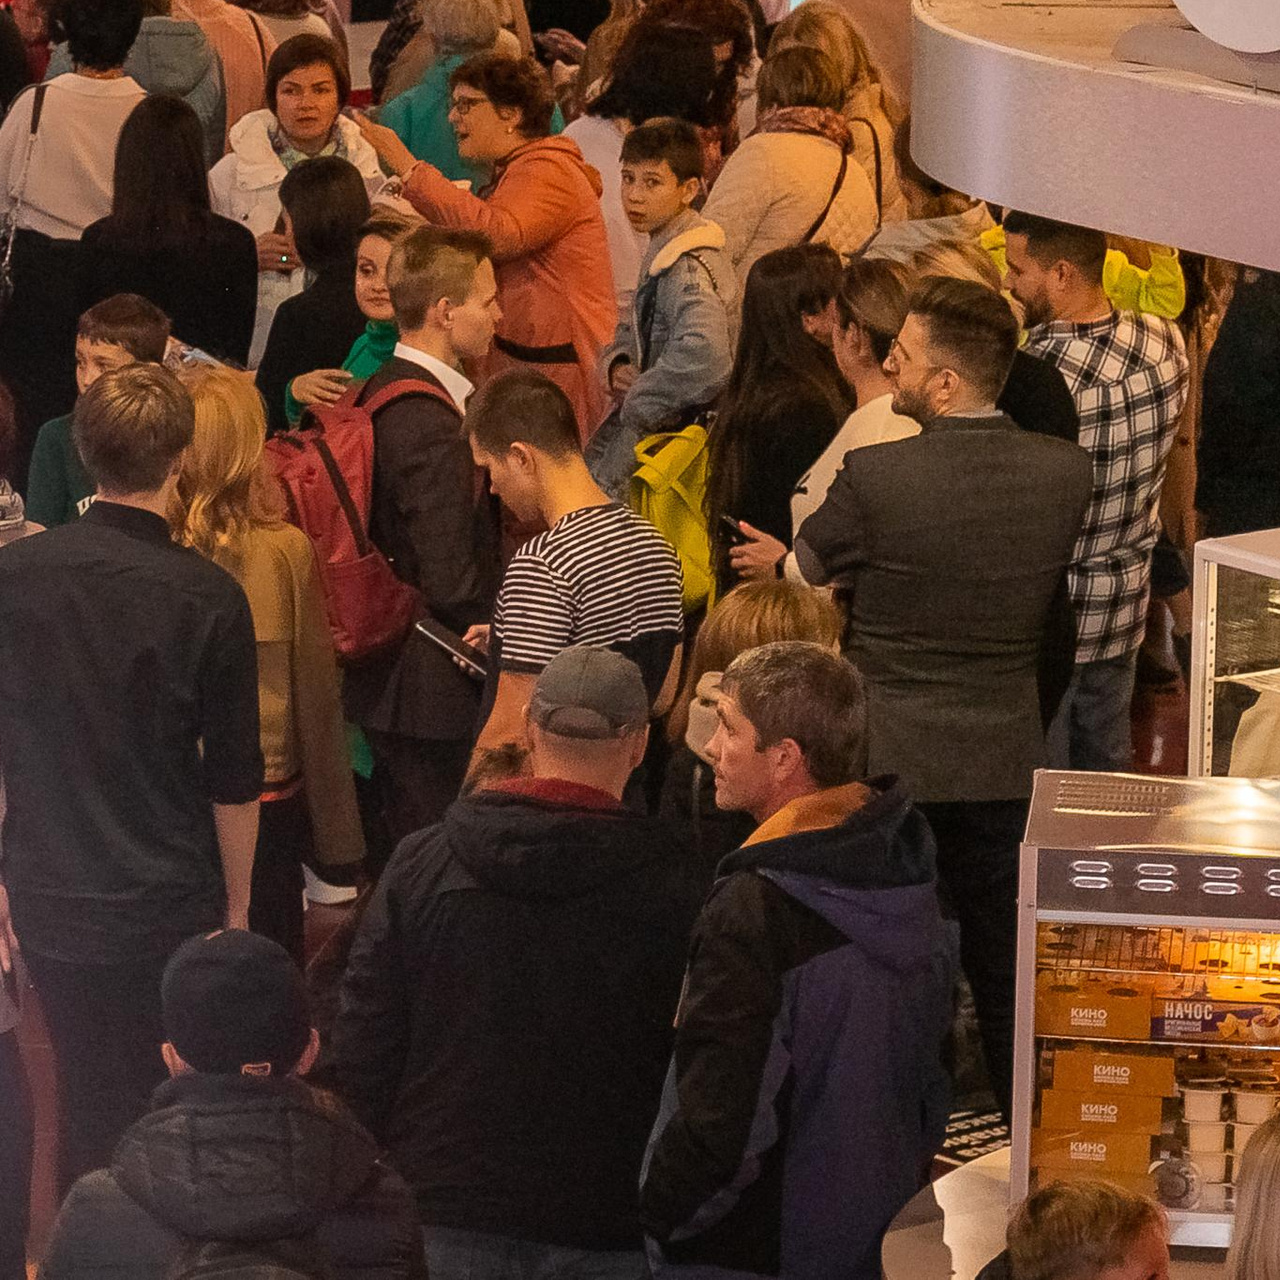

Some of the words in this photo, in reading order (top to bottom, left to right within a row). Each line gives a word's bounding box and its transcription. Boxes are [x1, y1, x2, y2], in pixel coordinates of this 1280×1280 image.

[1071, 1008, 1107, 1019] КИНО
[1165, 1001, 1213, 1020] НАЧОС
[1093, 1064, 1130, 1077] КИНО
[1081, 1104, 1118, 1115] КИНО
[1070, 1142, 1107, 1153] КИНО
